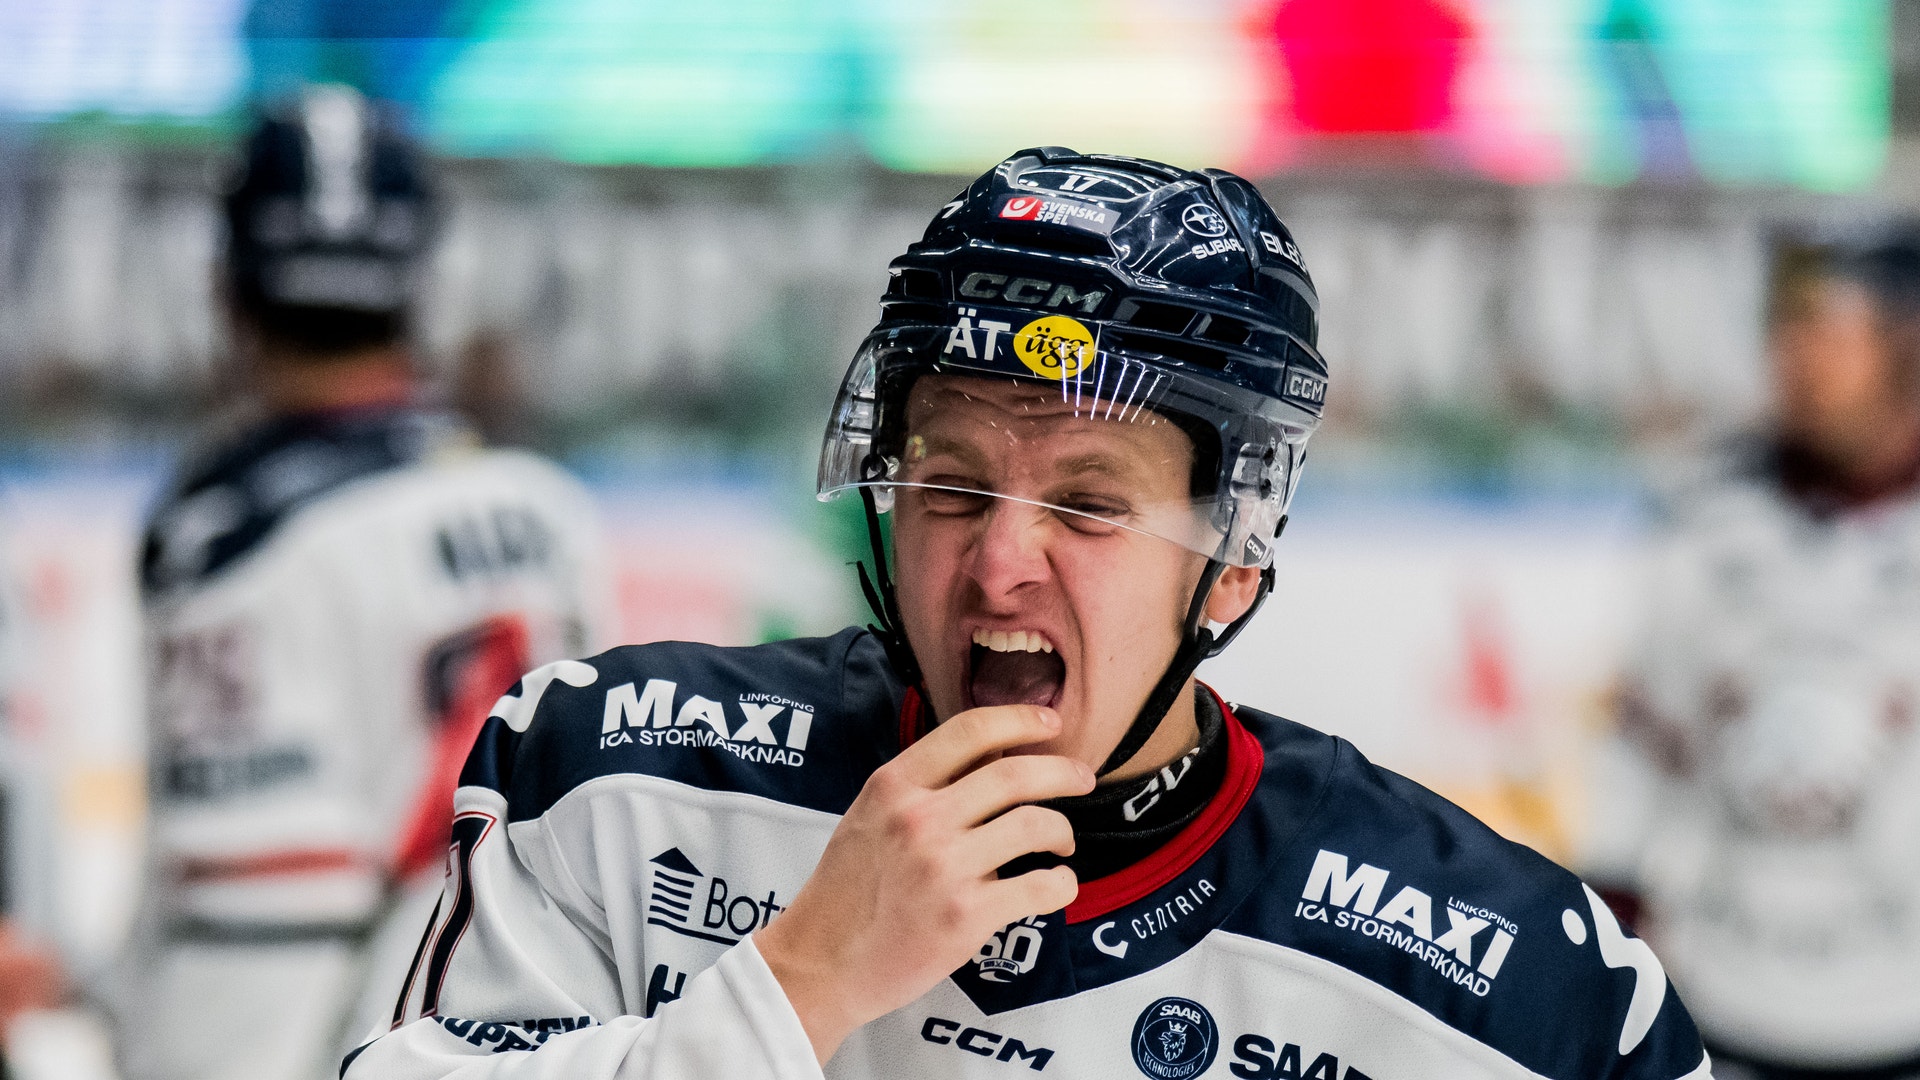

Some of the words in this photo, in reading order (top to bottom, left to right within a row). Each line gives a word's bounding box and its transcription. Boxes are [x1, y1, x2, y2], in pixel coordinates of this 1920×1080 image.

[1059, 174, 1107, 193] 17
[1034, 211, 1068, 226] SPEL
[1039, 201, 1106, 224] SVENSKA
[959, 272, 1107, 313] CCM
[944, 307, 1011, 361] ÄT
[1290, 375, 1325, 402] CCM
[1246, 538, 1263, 560] CCM
[602, 679, 813, 751] MAXI
[739, 693, 815, 713] LINKÖPING
[600, 731, 634, 750] ICA
[639, 729, 804, 767] STORMARKNAD
[703, 877, 786, 936] Bot
[1131, 879, 1216, 939] CENTRIA
[1301, 848, 1515, 980] MAXI
[1448, 896, 1519, 935] LINKÖPING
[1295, 901, 1329, 923] ICA
[1334, 910, 1491, 998] STORMARKNAD
[1159, 1004, 1201, 1025] SAAB
[920, 1016, 1056, 1072] CCM
[1143, 1050, 1196, 1078] TECHNOLOGIES
